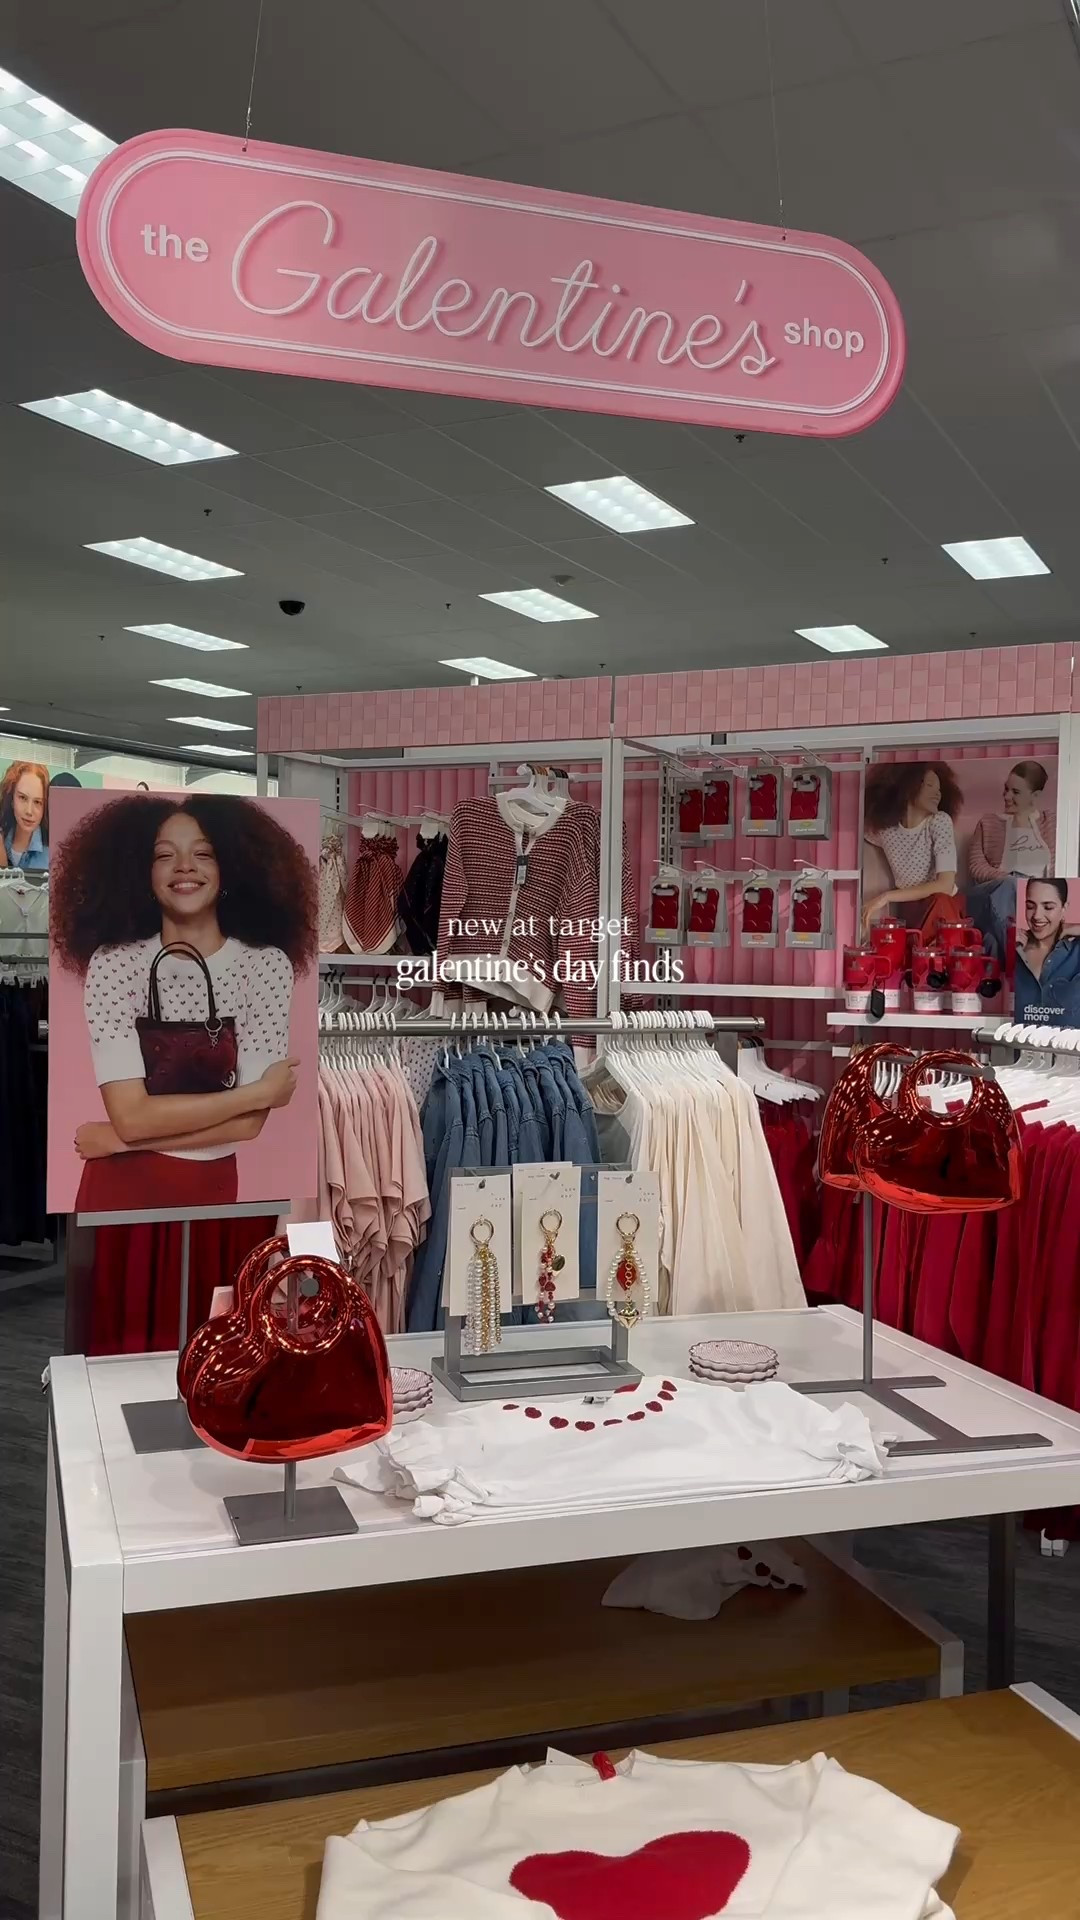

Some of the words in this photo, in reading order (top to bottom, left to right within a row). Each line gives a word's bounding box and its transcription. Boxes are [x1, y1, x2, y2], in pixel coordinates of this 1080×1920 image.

[140, 224, 209, 262] the
[231, 200, 776, 375] Galentine's
[784, 317, 864, 358] shop
[1023, 1004, 1065, 1015] discover
[1023, 1013, 1050, 1022] more
